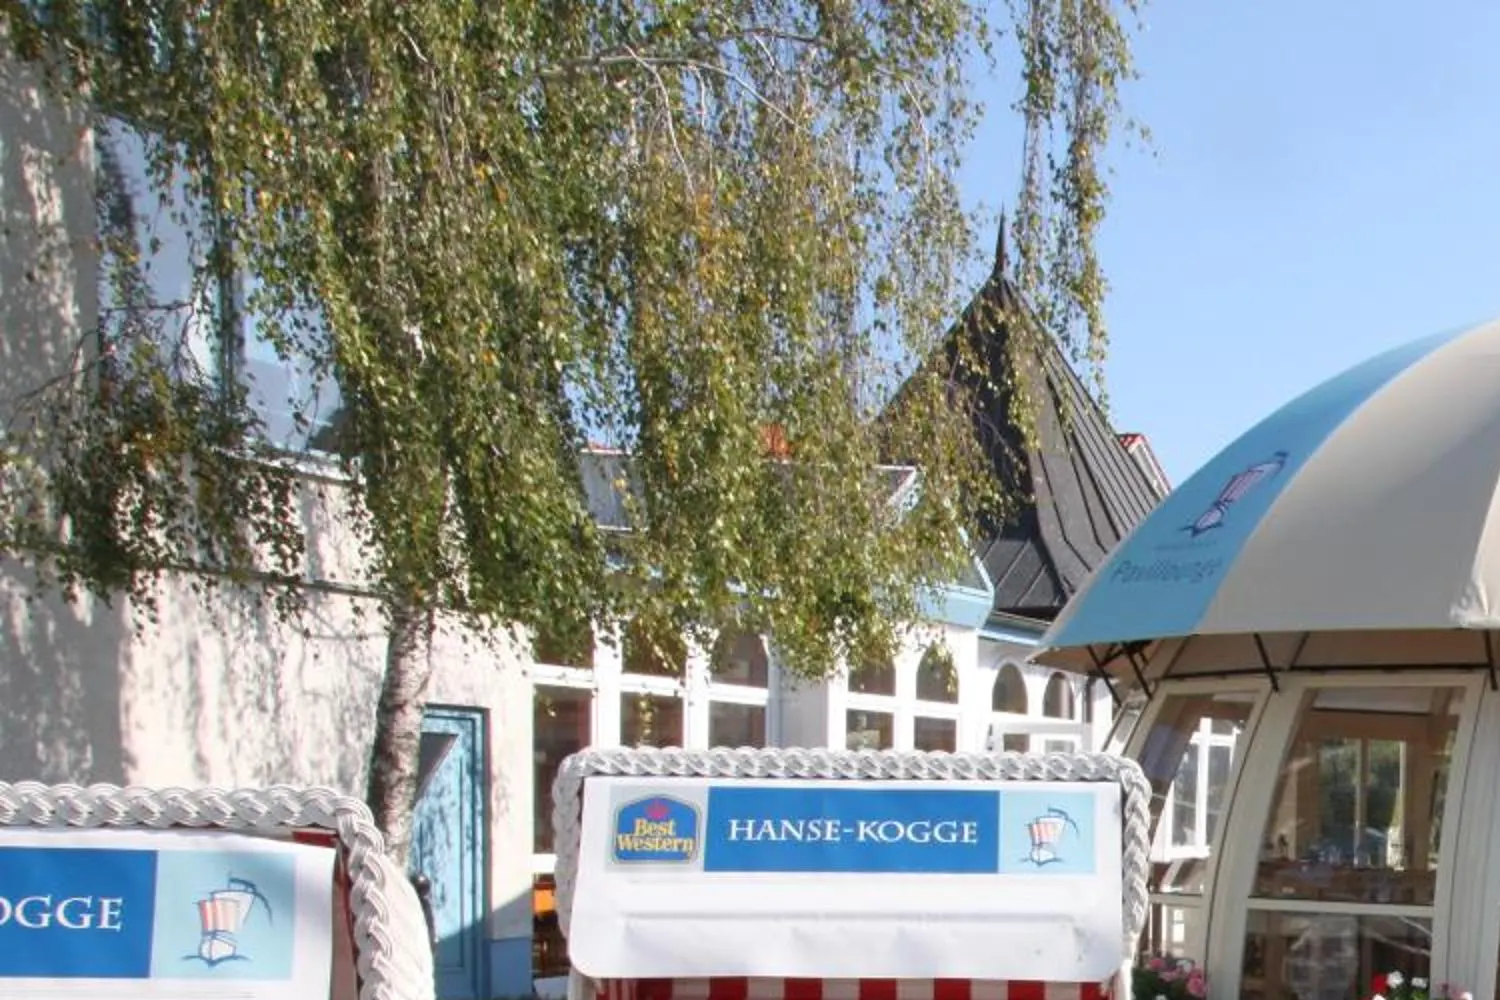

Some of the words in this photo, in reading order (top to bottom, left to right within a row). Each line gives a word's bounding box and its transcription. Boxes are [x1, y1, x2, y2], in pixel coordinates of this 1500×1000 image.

[634, 817, 676, 836] Best
[728, 818, 978, 844] HANSE-KOGGE
[616, 834, 694, 853] Western
